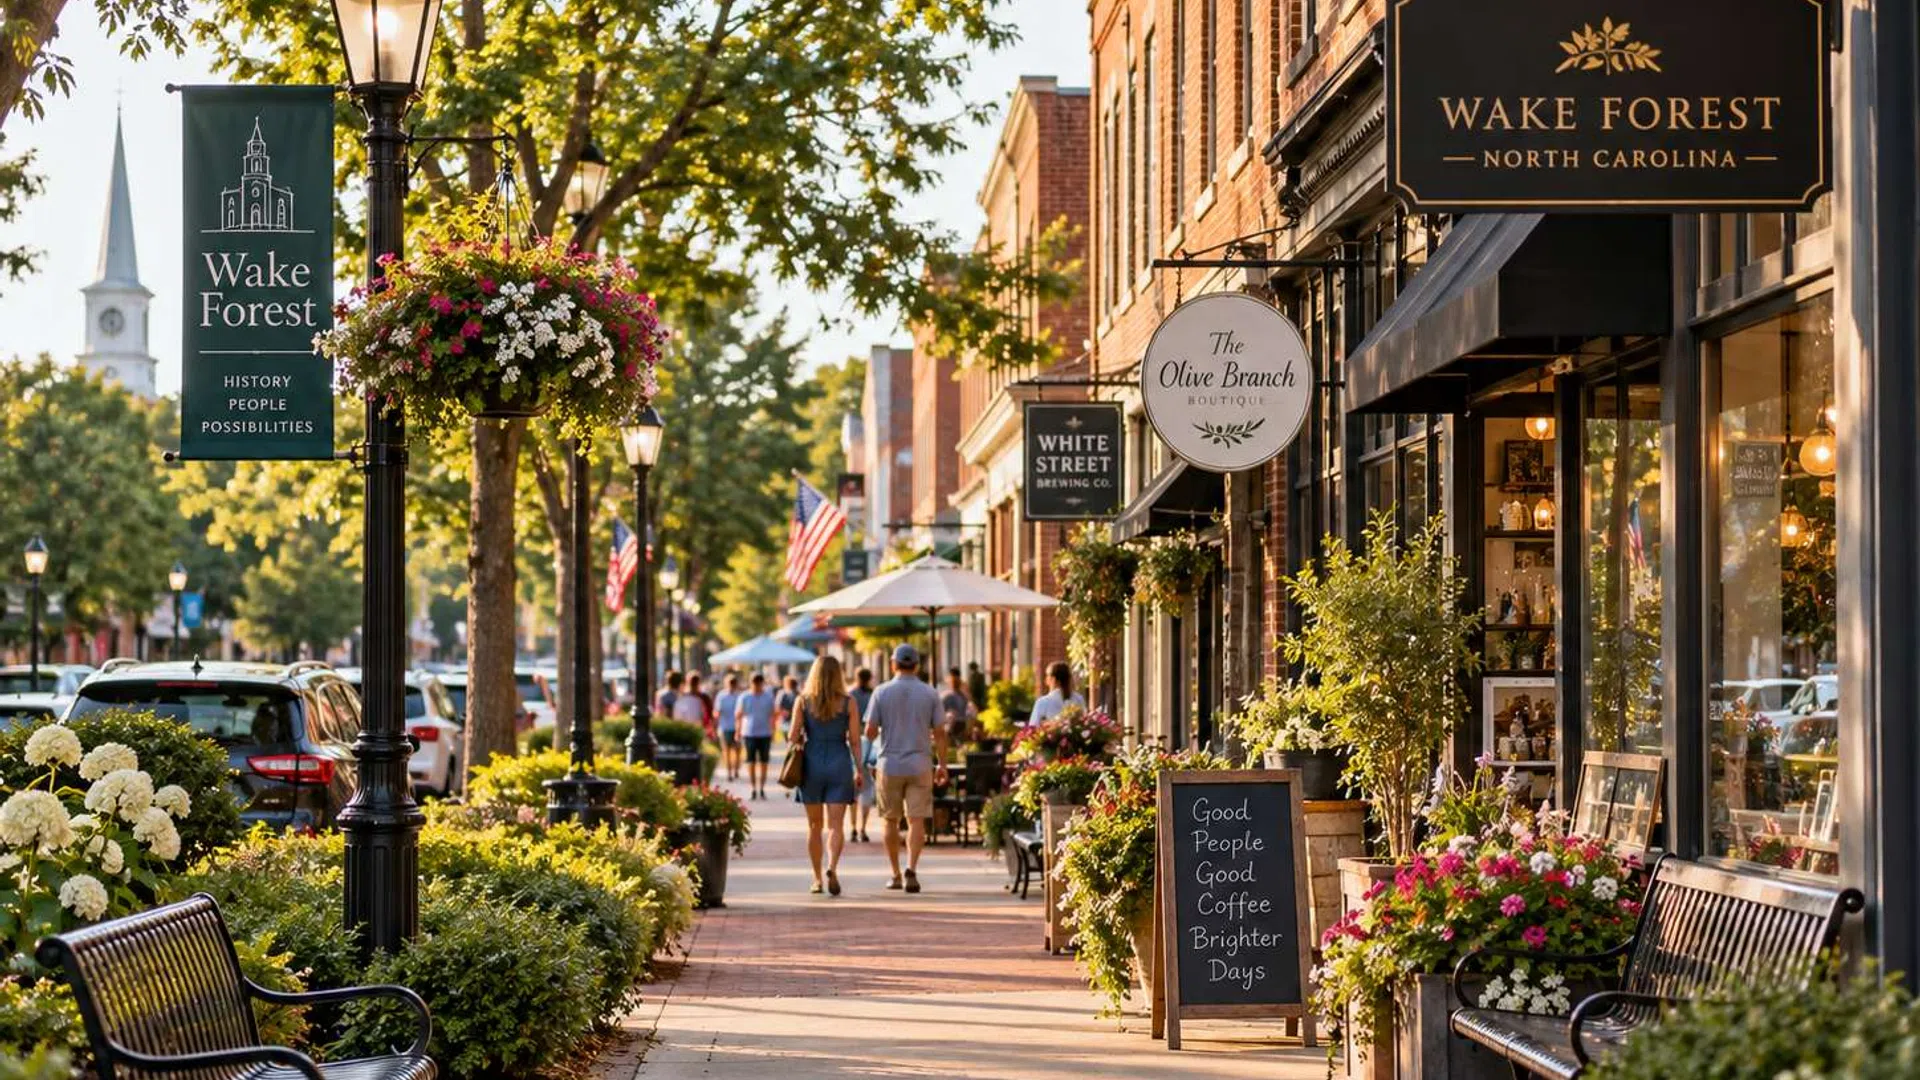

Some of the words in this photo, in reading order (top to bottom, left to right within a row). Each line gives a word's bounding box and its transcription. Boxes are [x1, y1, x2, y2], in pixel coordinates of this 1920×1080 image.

[1439, 96, 1577, 130] WAKE
[1601, 96, 1781, 130] FOREST
[1483, 149, 1579, 168] NORTH
[1593, 149, 1736, 168] CAROLINA
[201, 250, 311, 288] Wake
[199, 291, 317, 327] Forest
[1209, 329, 1245, 356] The
[224, 375, 292, 388] HISTORY
[1159, 360, 1214, 389] Olive
[1220, 360, 1296, 388] Branch
[229, 398, 287, 411] PEOPLE
[1187, 395, 1265, 408] BOUTIQUE
[201, 420, 313, 434] POSSIBILITIES
[1037, 434, 1109, 452] WHITE
[1035, 456, 1111, 473] STREET
[1036, 477, 1090, 489] BREWING
[1092, 478, 1112, 488] CO.
[1192, 797, 1252, 827] Good
[1191, 829, 1264, 859] People
[1195, 860, 1256, 888] Good
[1197, 891, 1272, 921] Coffee
[1189, 925, 1283, 957] Brighter
[1207, 958, 1267, 991] Days
